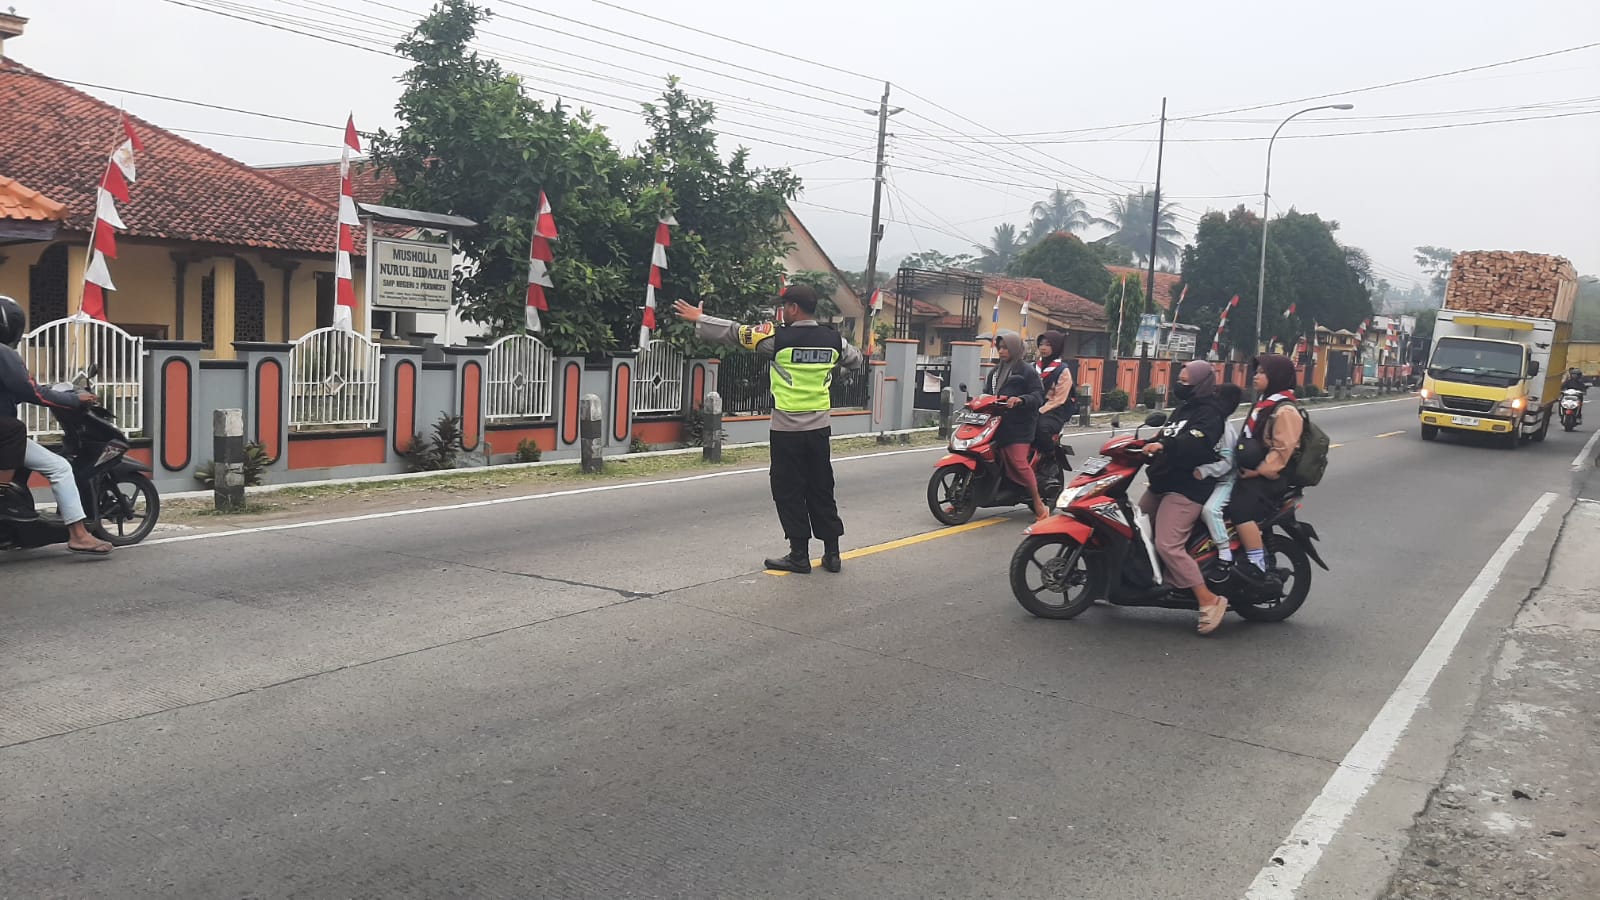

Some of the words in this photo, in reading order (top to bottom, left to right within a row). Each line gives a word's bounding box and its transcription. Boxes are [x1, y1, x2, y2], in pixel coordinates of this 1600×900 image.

[393, 248, 437, 264] MUSHOLLA
[379, 263, 411, 277] NURUL
[412, 266, 449, 280] HIDAYAH
[382, 279, 395, 287] SMP
[793, 350, 831, 362] POLISI
